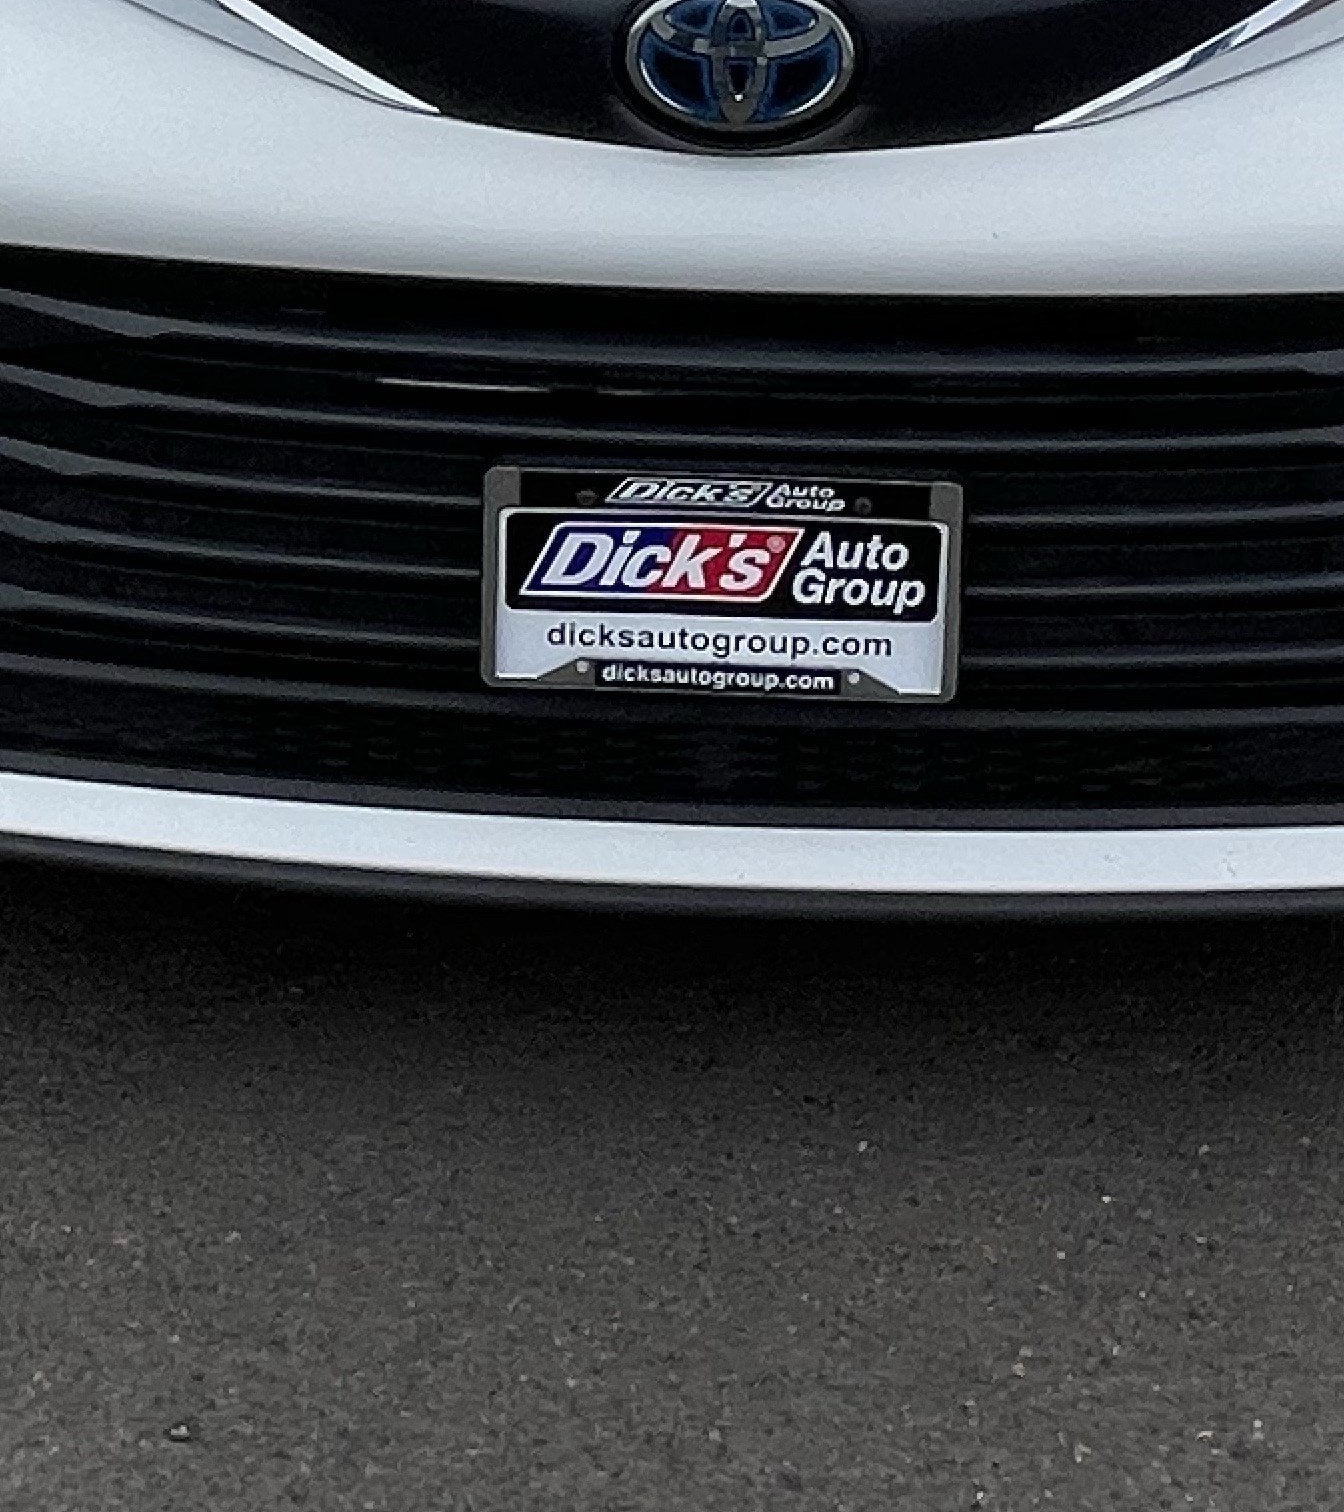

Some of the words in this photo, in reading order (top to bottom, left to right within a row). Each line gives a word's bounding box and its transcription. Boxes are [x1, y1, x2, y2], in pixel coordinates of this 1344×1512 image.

[540, 531, 771, 591] Dick's
[801, 531, 910, 571] Auto
[792, 568, 926, 614] Group
[546, 622, 892, 659] dicksautogroup.com
[601, 662, 834, 691] dicksautogroup.com
